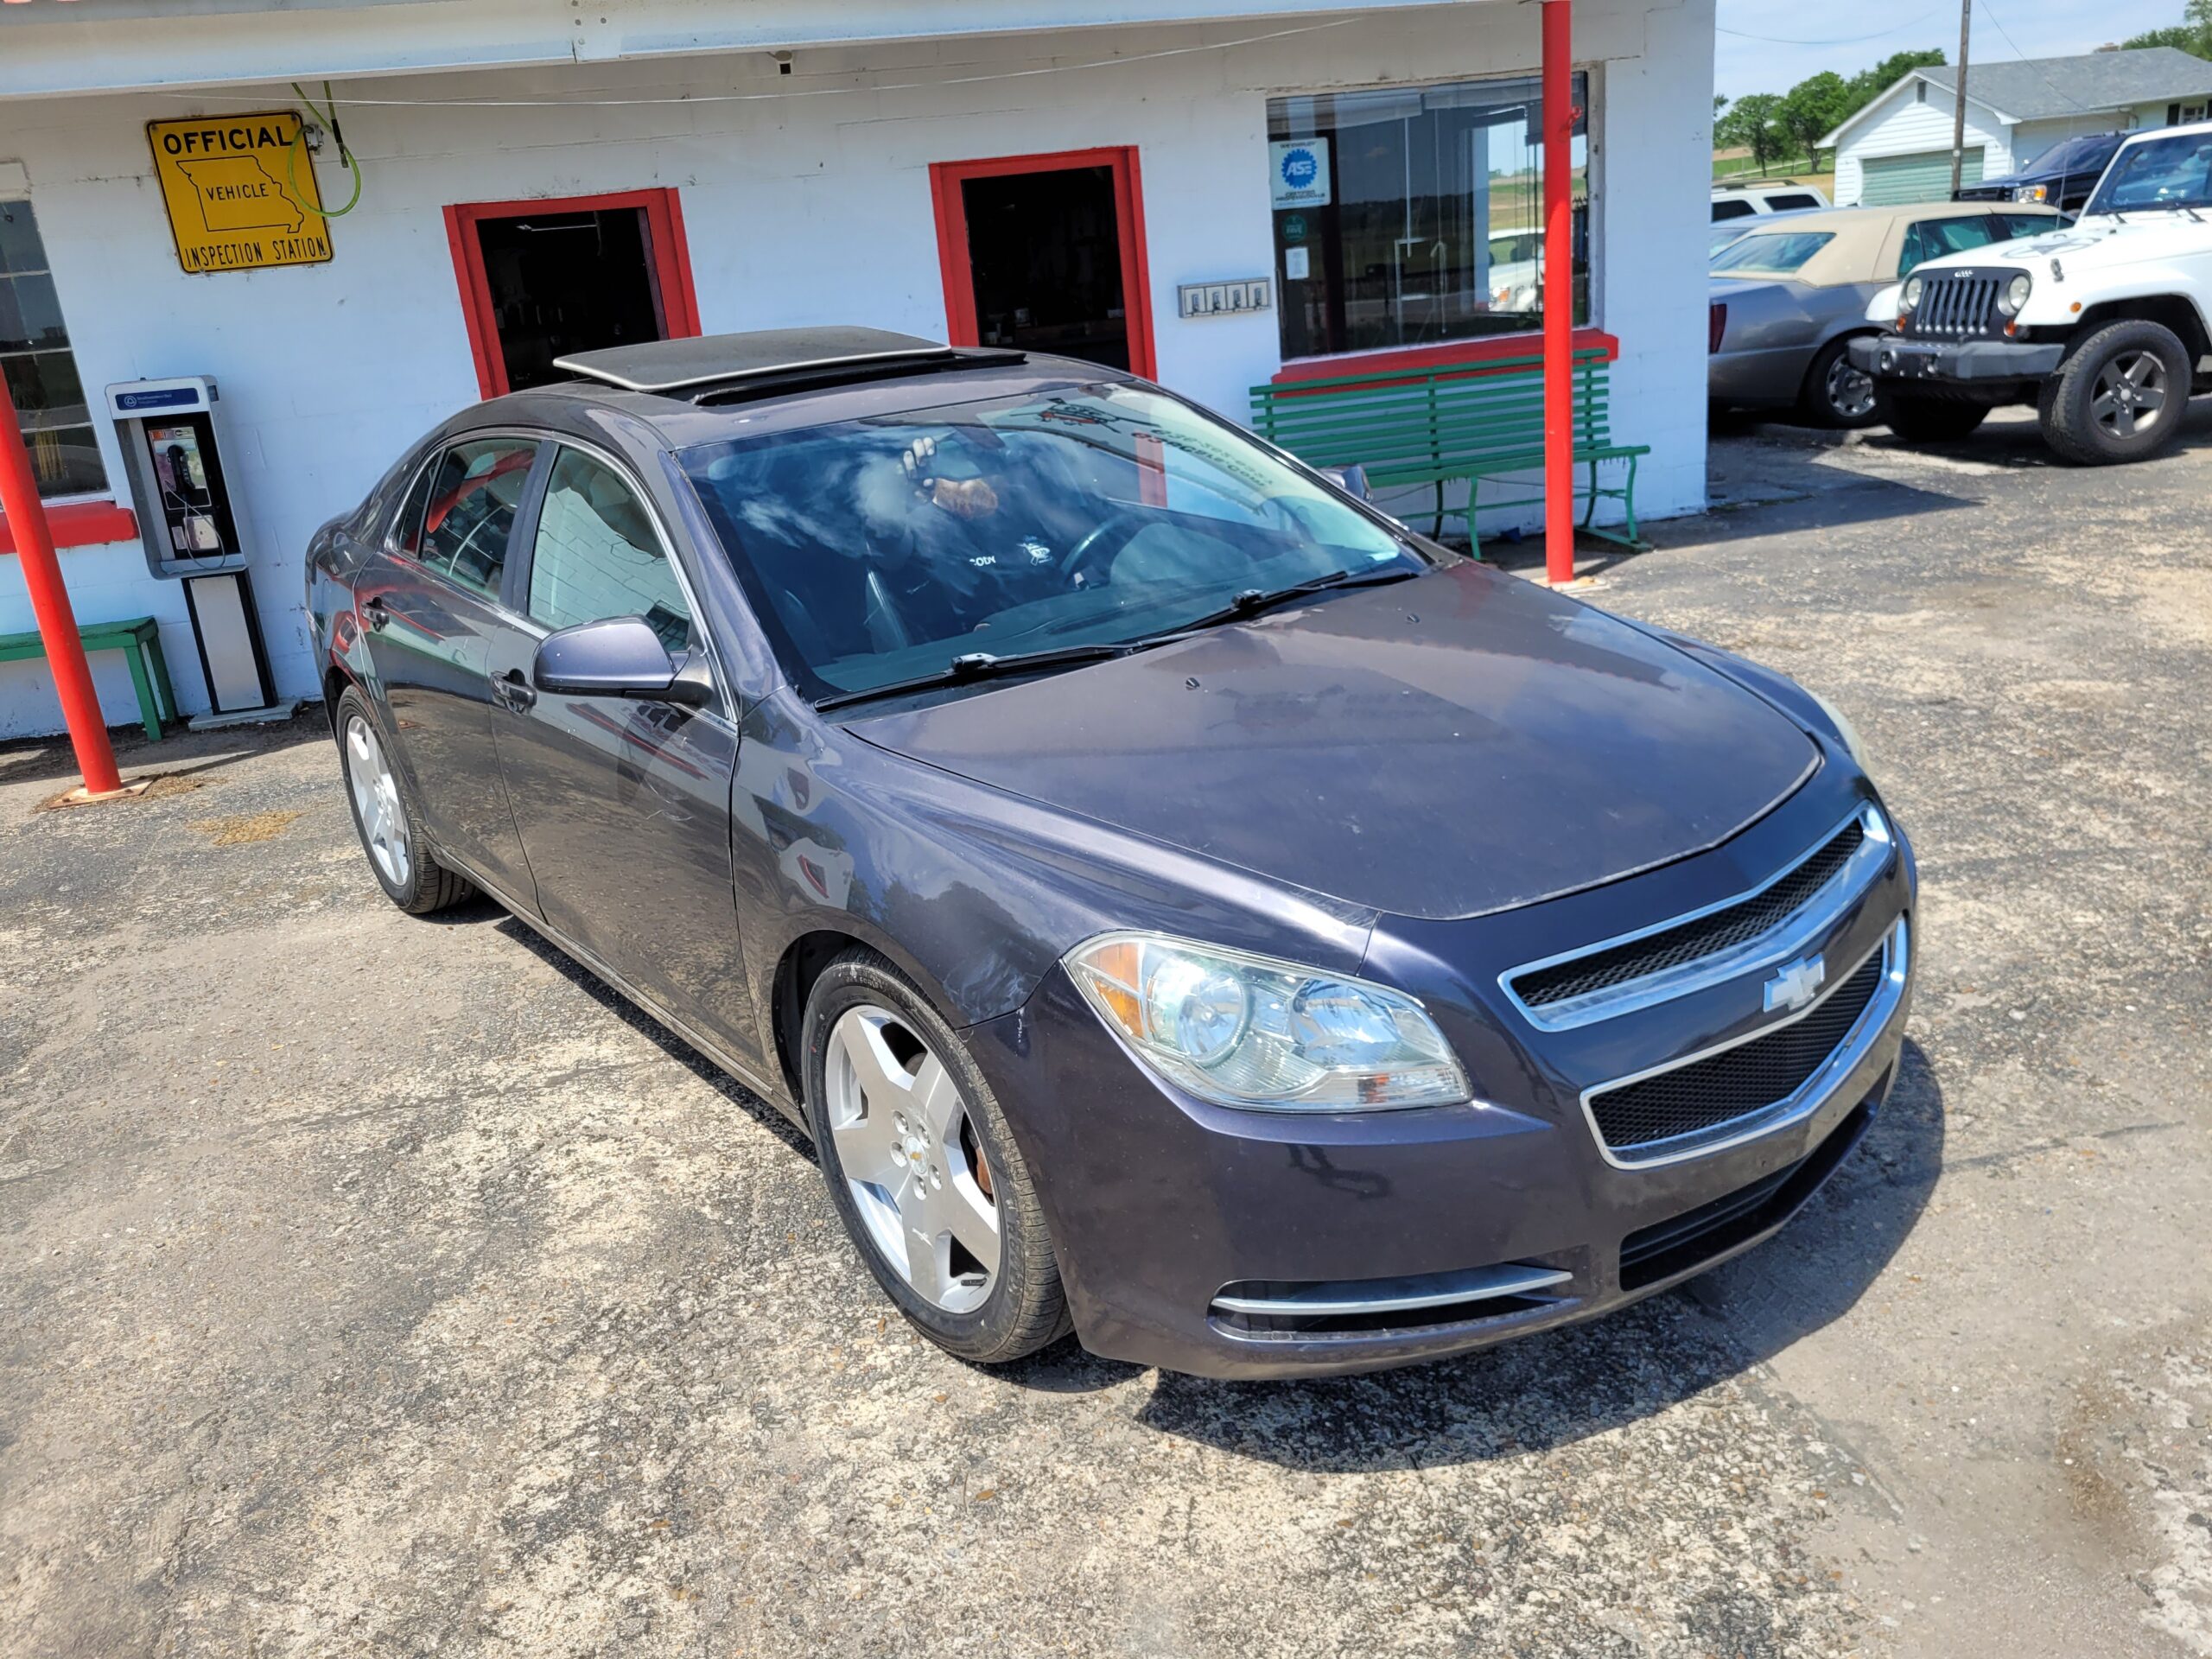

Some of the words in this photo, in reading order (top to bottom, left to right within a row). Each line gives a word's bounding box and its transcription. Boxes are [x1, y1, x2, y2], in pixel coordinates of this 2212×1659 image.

[163, 126, 294, 155] OFFICIAL
[1286, 161, 1312, 176] ASE
[206, 183, 269, 200] VEHICLE
[185, 242, 264, 268] INSPECTION
[272, 236, 327, 260] STATION
